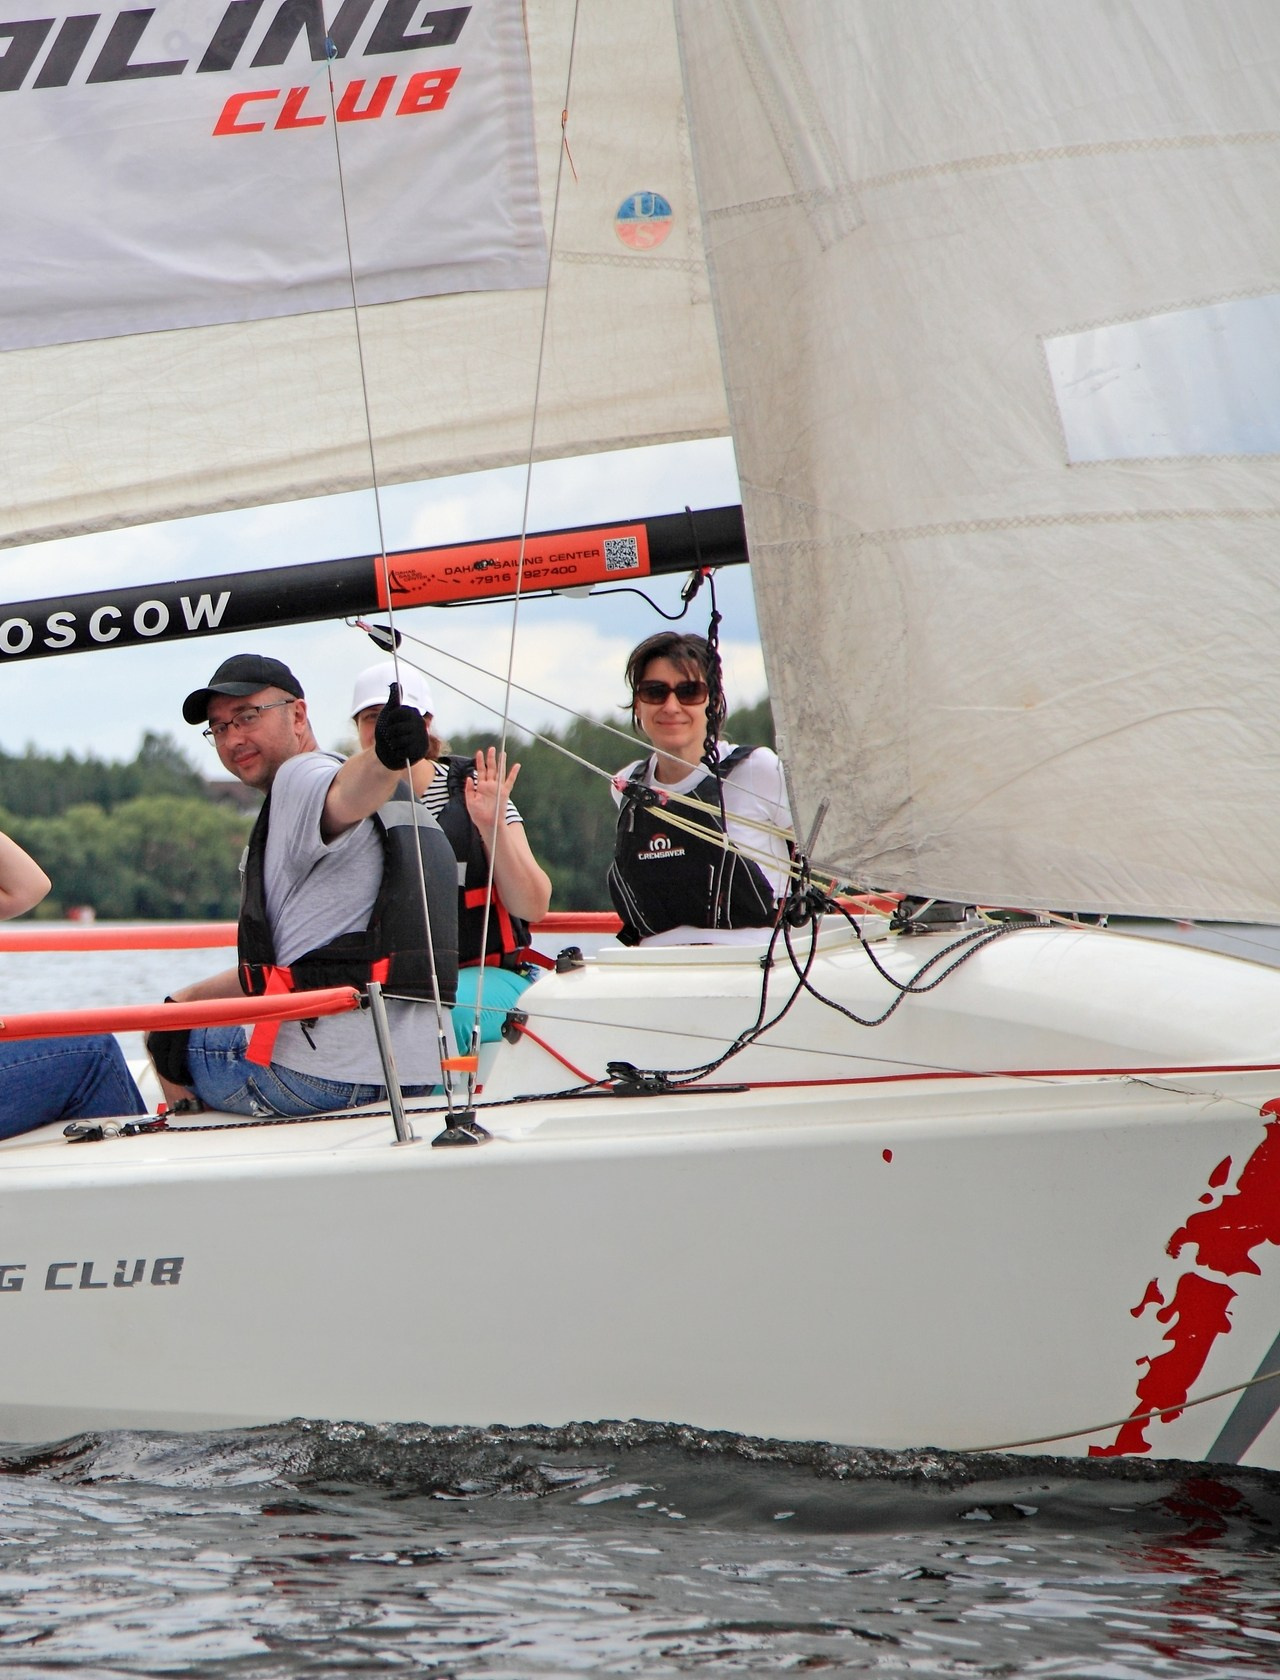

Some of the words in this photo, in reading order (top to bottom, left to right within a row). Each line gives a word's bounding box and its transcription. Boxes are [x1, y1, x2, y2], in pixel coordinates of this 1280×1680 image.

[212, 67, 462, 136] CLUB
[549, 549, 600, 562] CENTER
[638, 849, 685, 860] CREWSAVER
[44, 1257, 185, 1291] CLUB
